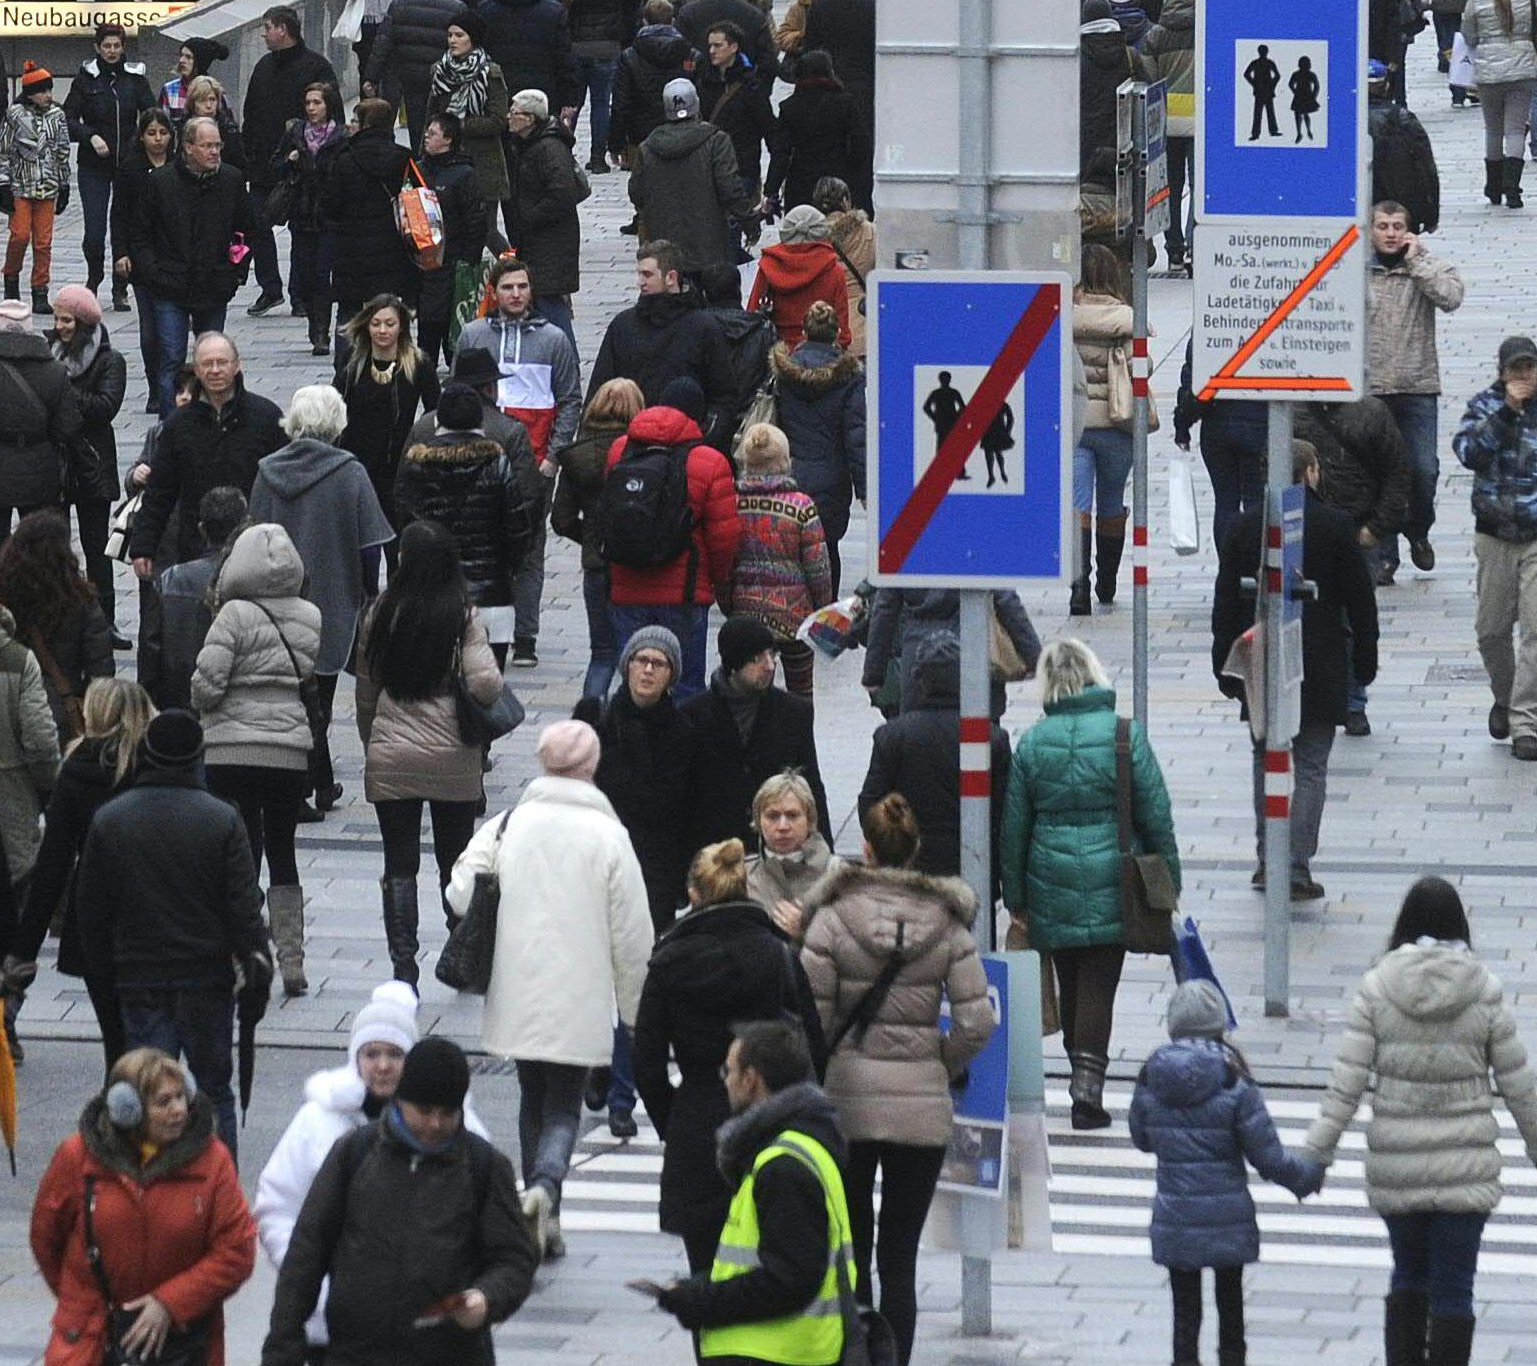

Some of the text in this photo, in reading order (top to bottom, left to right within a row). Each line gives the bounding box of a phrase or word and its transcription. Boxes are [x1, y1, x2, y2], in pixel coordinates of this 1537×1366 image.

[1230, 275, 1250, 290] die
[1308, 297, 1335, 311] Taxi
[1206, 338, 1233, 349] zum
[1281, 337, 1351, 354] Einsteigen
[1259, 357, 1297, 370] sowie
